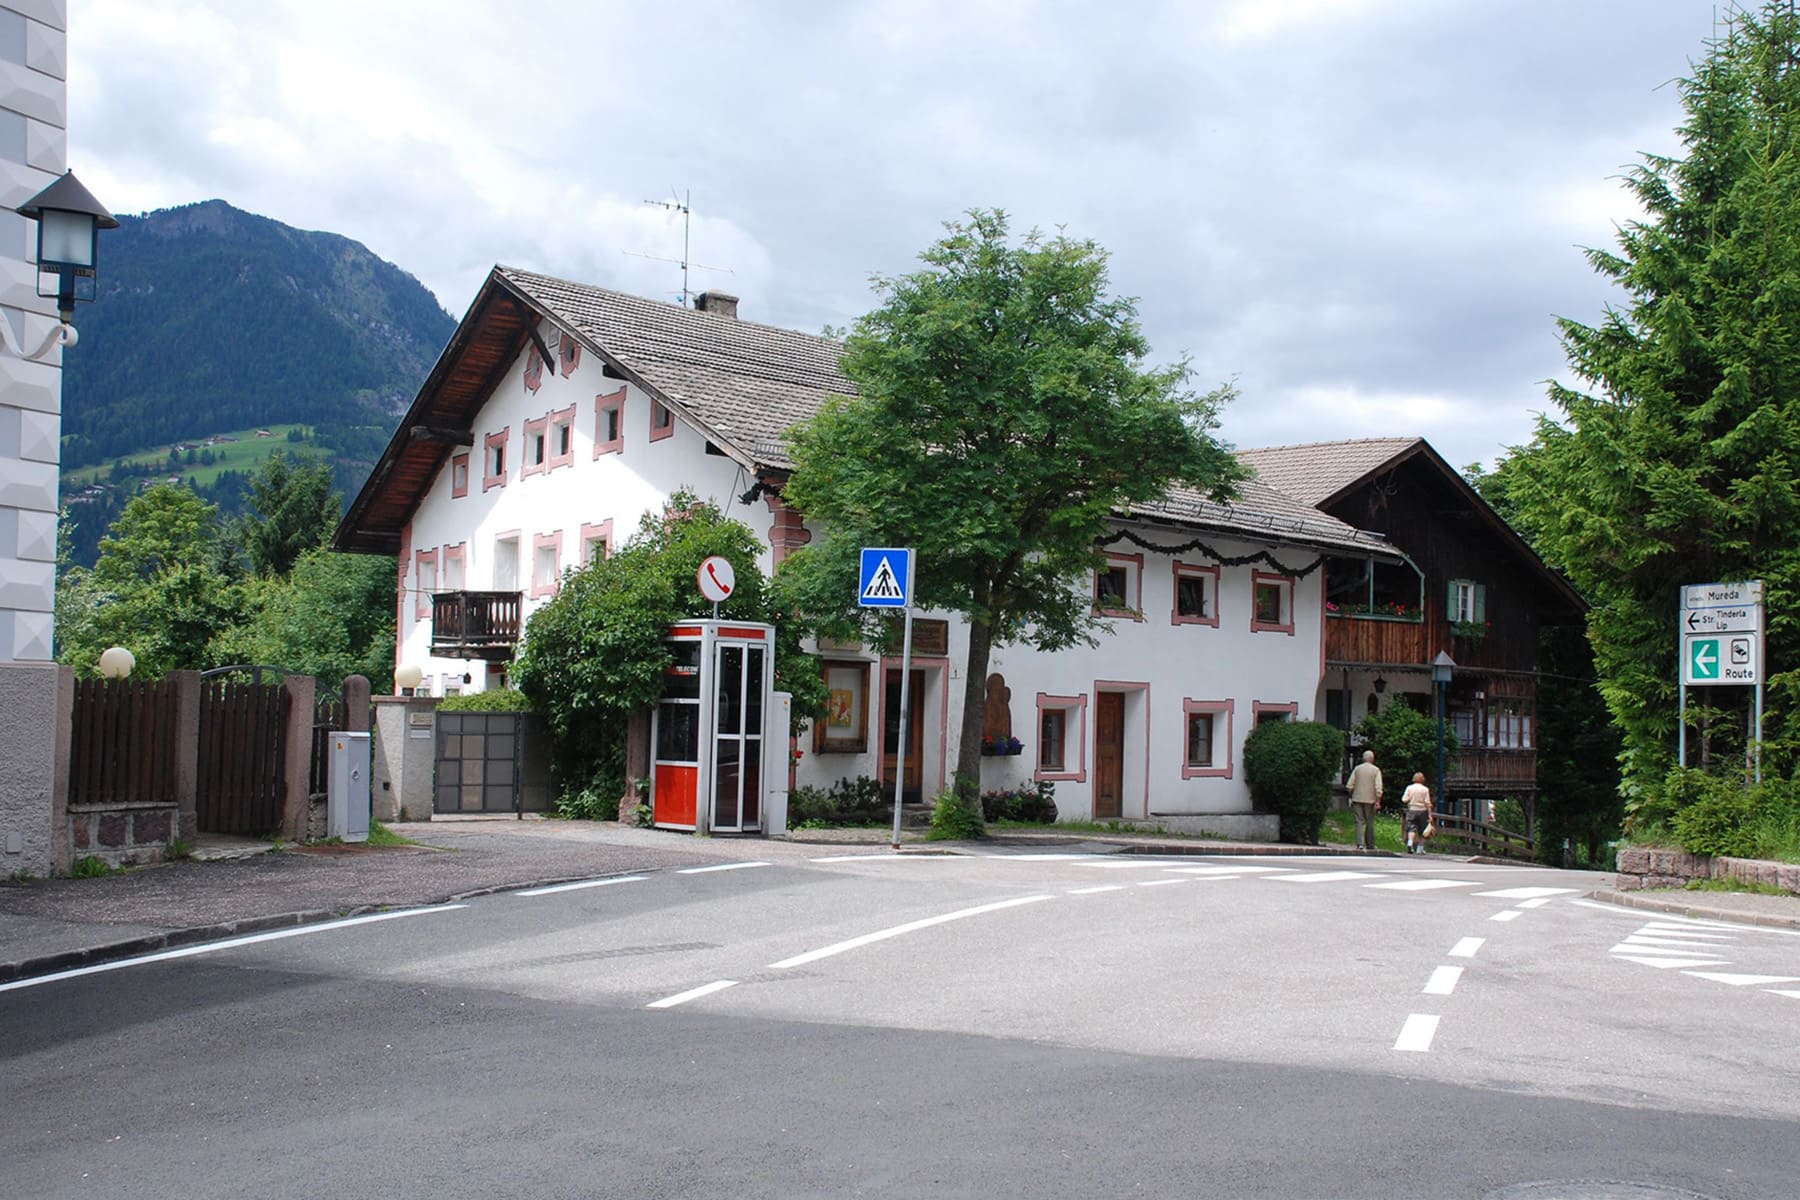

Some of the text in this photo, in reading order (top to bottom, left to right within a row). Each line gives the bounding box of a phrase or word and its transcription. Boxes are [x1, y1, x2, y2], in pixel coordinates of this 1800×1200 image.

[1708, 590, 1739, 601] Mureda
[1702, 615, 1715, 624] Str.
[1725, 668, 1753, 679] Route
